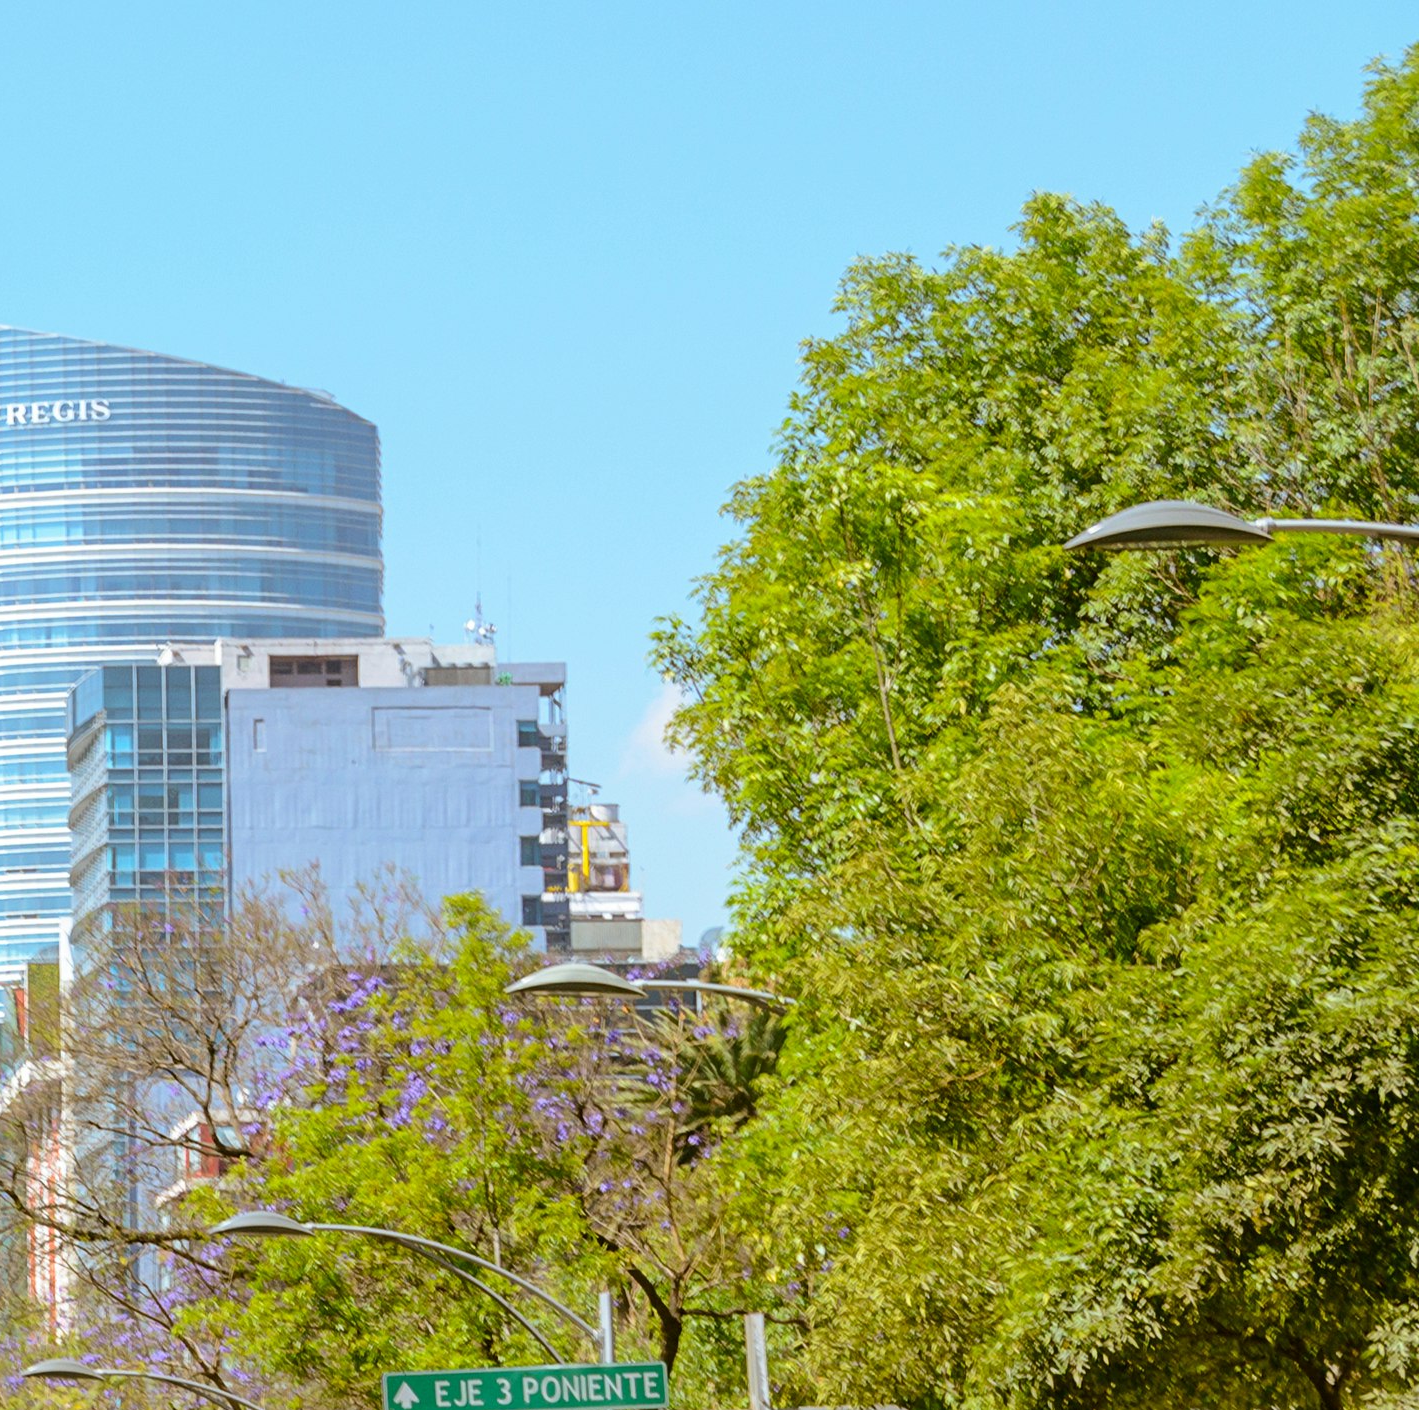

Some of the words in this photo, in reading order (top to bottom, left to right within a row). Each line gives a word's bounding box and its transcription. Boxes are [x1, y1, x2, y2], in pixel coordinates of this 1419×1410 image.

[6, 399, 111, 426] REGIS
[434, 1379, 485, 1408] EJE
[496, 1378, 513, 1406] 3
[522, 1371, 661, 1405] PONIENTE
